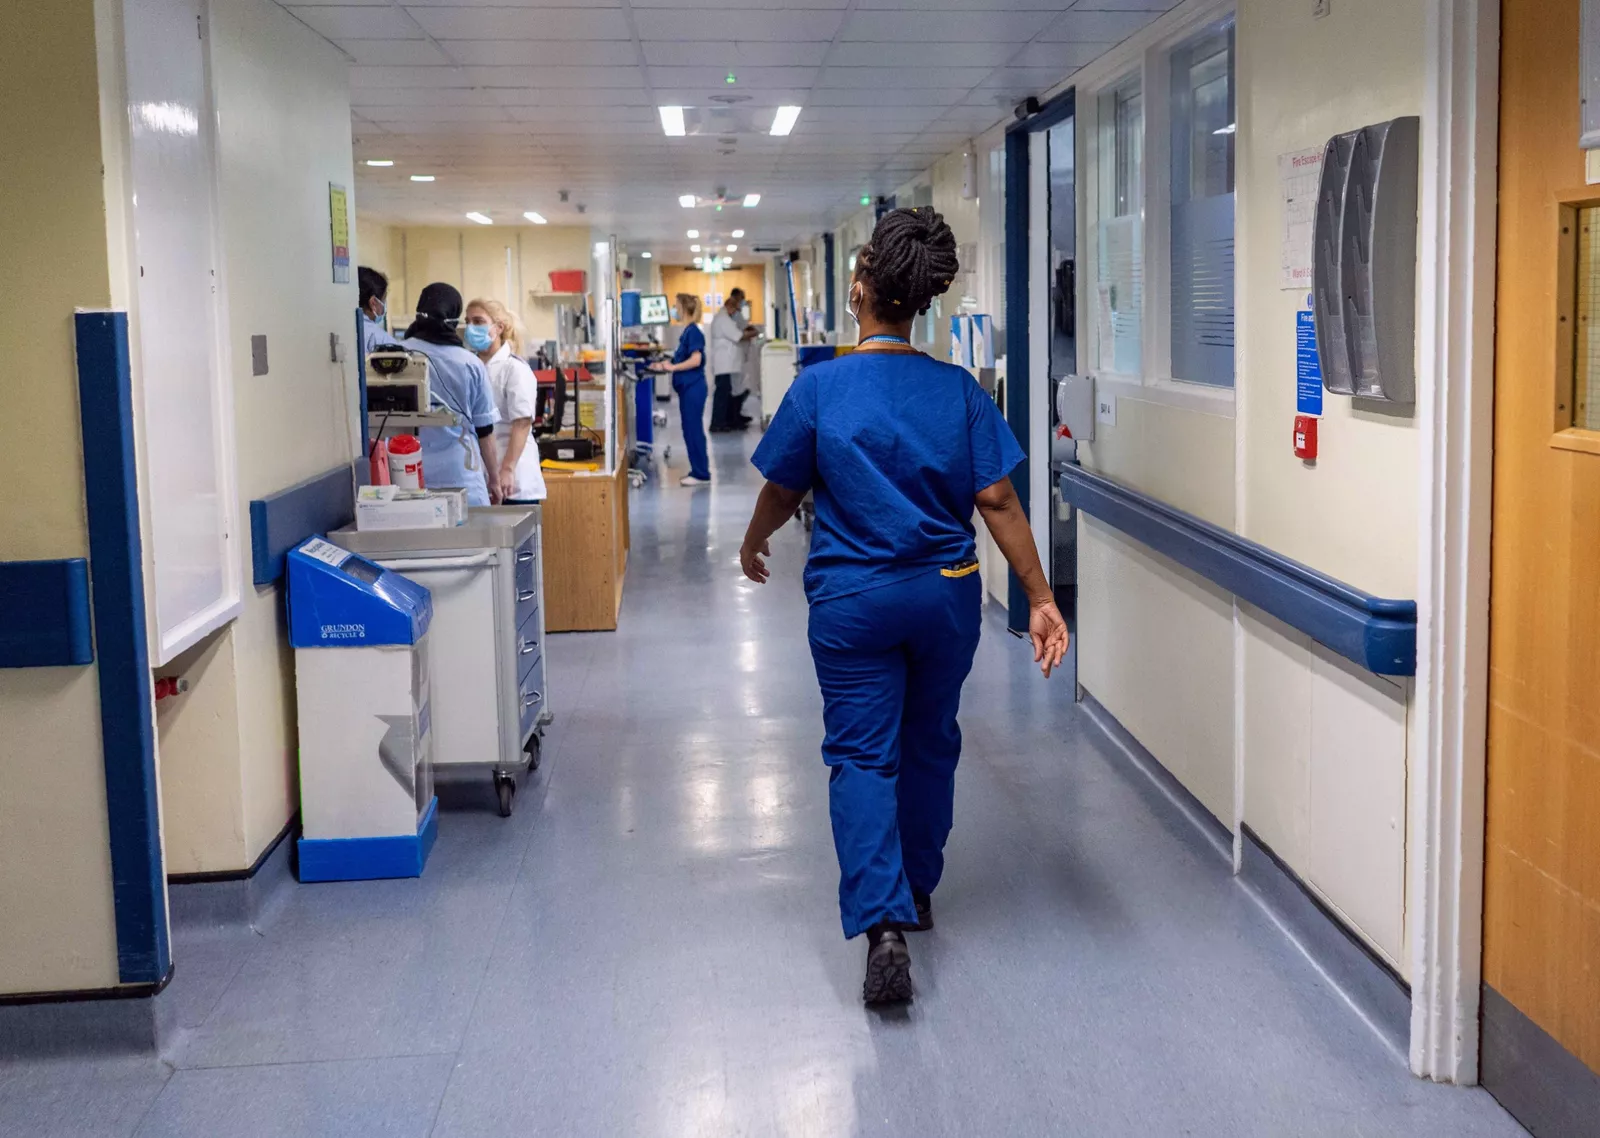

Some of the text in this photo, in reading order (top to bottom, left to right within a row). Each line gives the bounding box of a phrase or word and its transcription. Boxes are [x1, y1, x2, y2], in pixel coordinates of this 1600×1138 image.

[1292, 157, 1301, 168] Fire
[1301, 155, 1317, 167] Escape
[320, 624, 365, 632] GRUNDON
